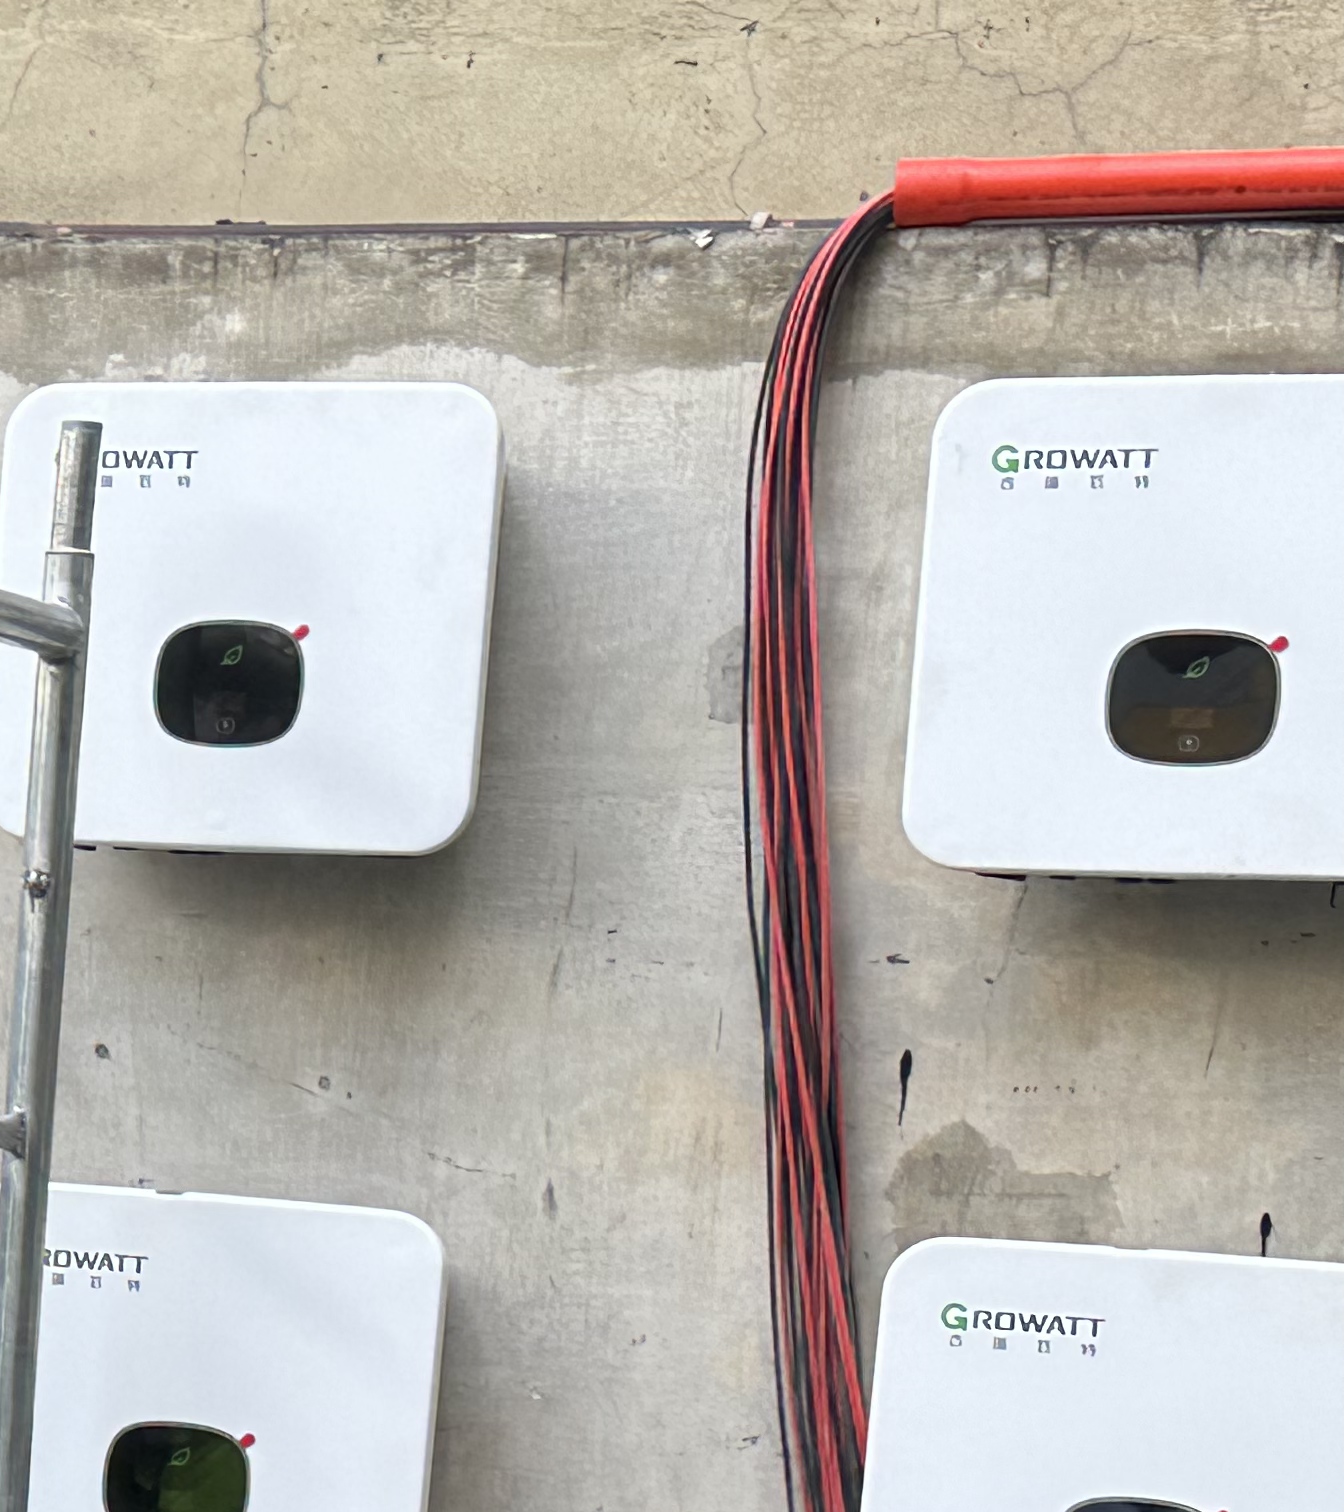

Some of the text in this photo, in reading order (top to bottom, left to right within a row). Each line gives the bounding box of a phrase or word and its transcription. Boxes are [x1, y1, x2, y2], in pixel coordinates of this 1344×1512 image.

[101, 450, 199, 469] OWATT
[992, 444, 1159, 473] GROWATT
[940, 1302, 1106, 1337] GROWATT
